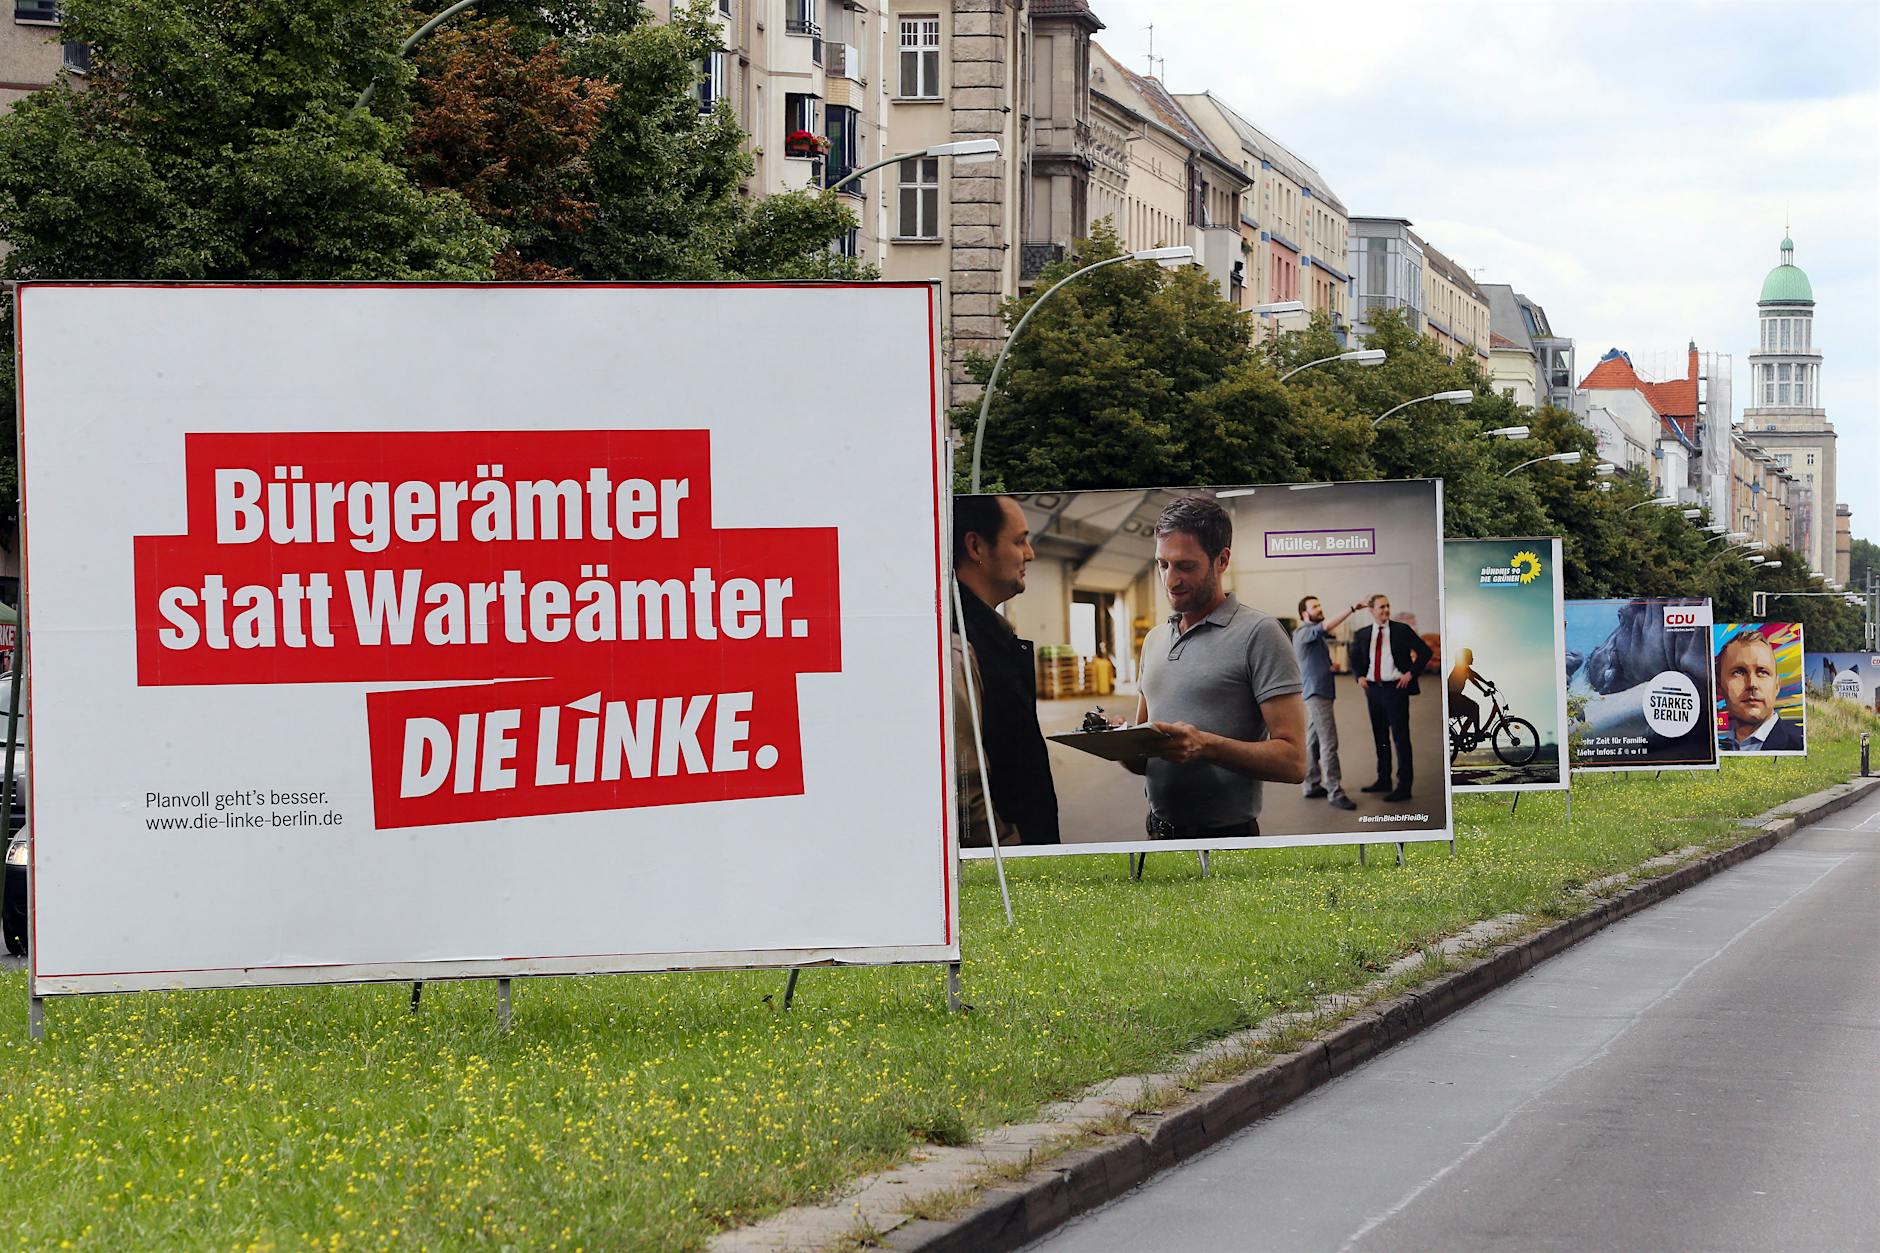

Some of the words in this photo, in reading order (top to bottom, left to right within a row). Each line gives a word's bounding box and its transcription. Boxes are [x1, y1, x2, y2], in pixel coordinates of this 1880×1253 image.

[215, 465, 688, 553] Bürgerämter
[1271, 537, 1321, 551] Müller,
[1326, 536, 1368, 549] Berlin
[1481, 567, 1510, 575] BÜNDNIS
[1512, 567, 1521, 575] 90
[1480, 575, 1491, 583] DIE
[1493, 574, 1520, 582] GRÜNEN
[159, 573, 334, 650] statt
[345, 565, 808, 645] Warteämter.
[1666, 614, 1695, 625] CDU
[1650, 695, 1693, 710] STARKES
[1653, 708, 1689, 722] BERLIN
[400, 709, 520, 798] DIE
[535, 692, 778, 786] LINKE.
[1596, 737, 1610, 745] Zeit
[1622, 736, 1649, 744] Familie.
[1596, 747, 1616, 756] Infos:
[146, 791, 209, 808] Planvoll
[215, 789, 265, 811] geht’s
[270, 789, 329, 805] besser.
[146, 810, 343, 830] www.die-linke-berlin.de
[1358, 813, 1429, 823] #BerlinBleibtFleißig
